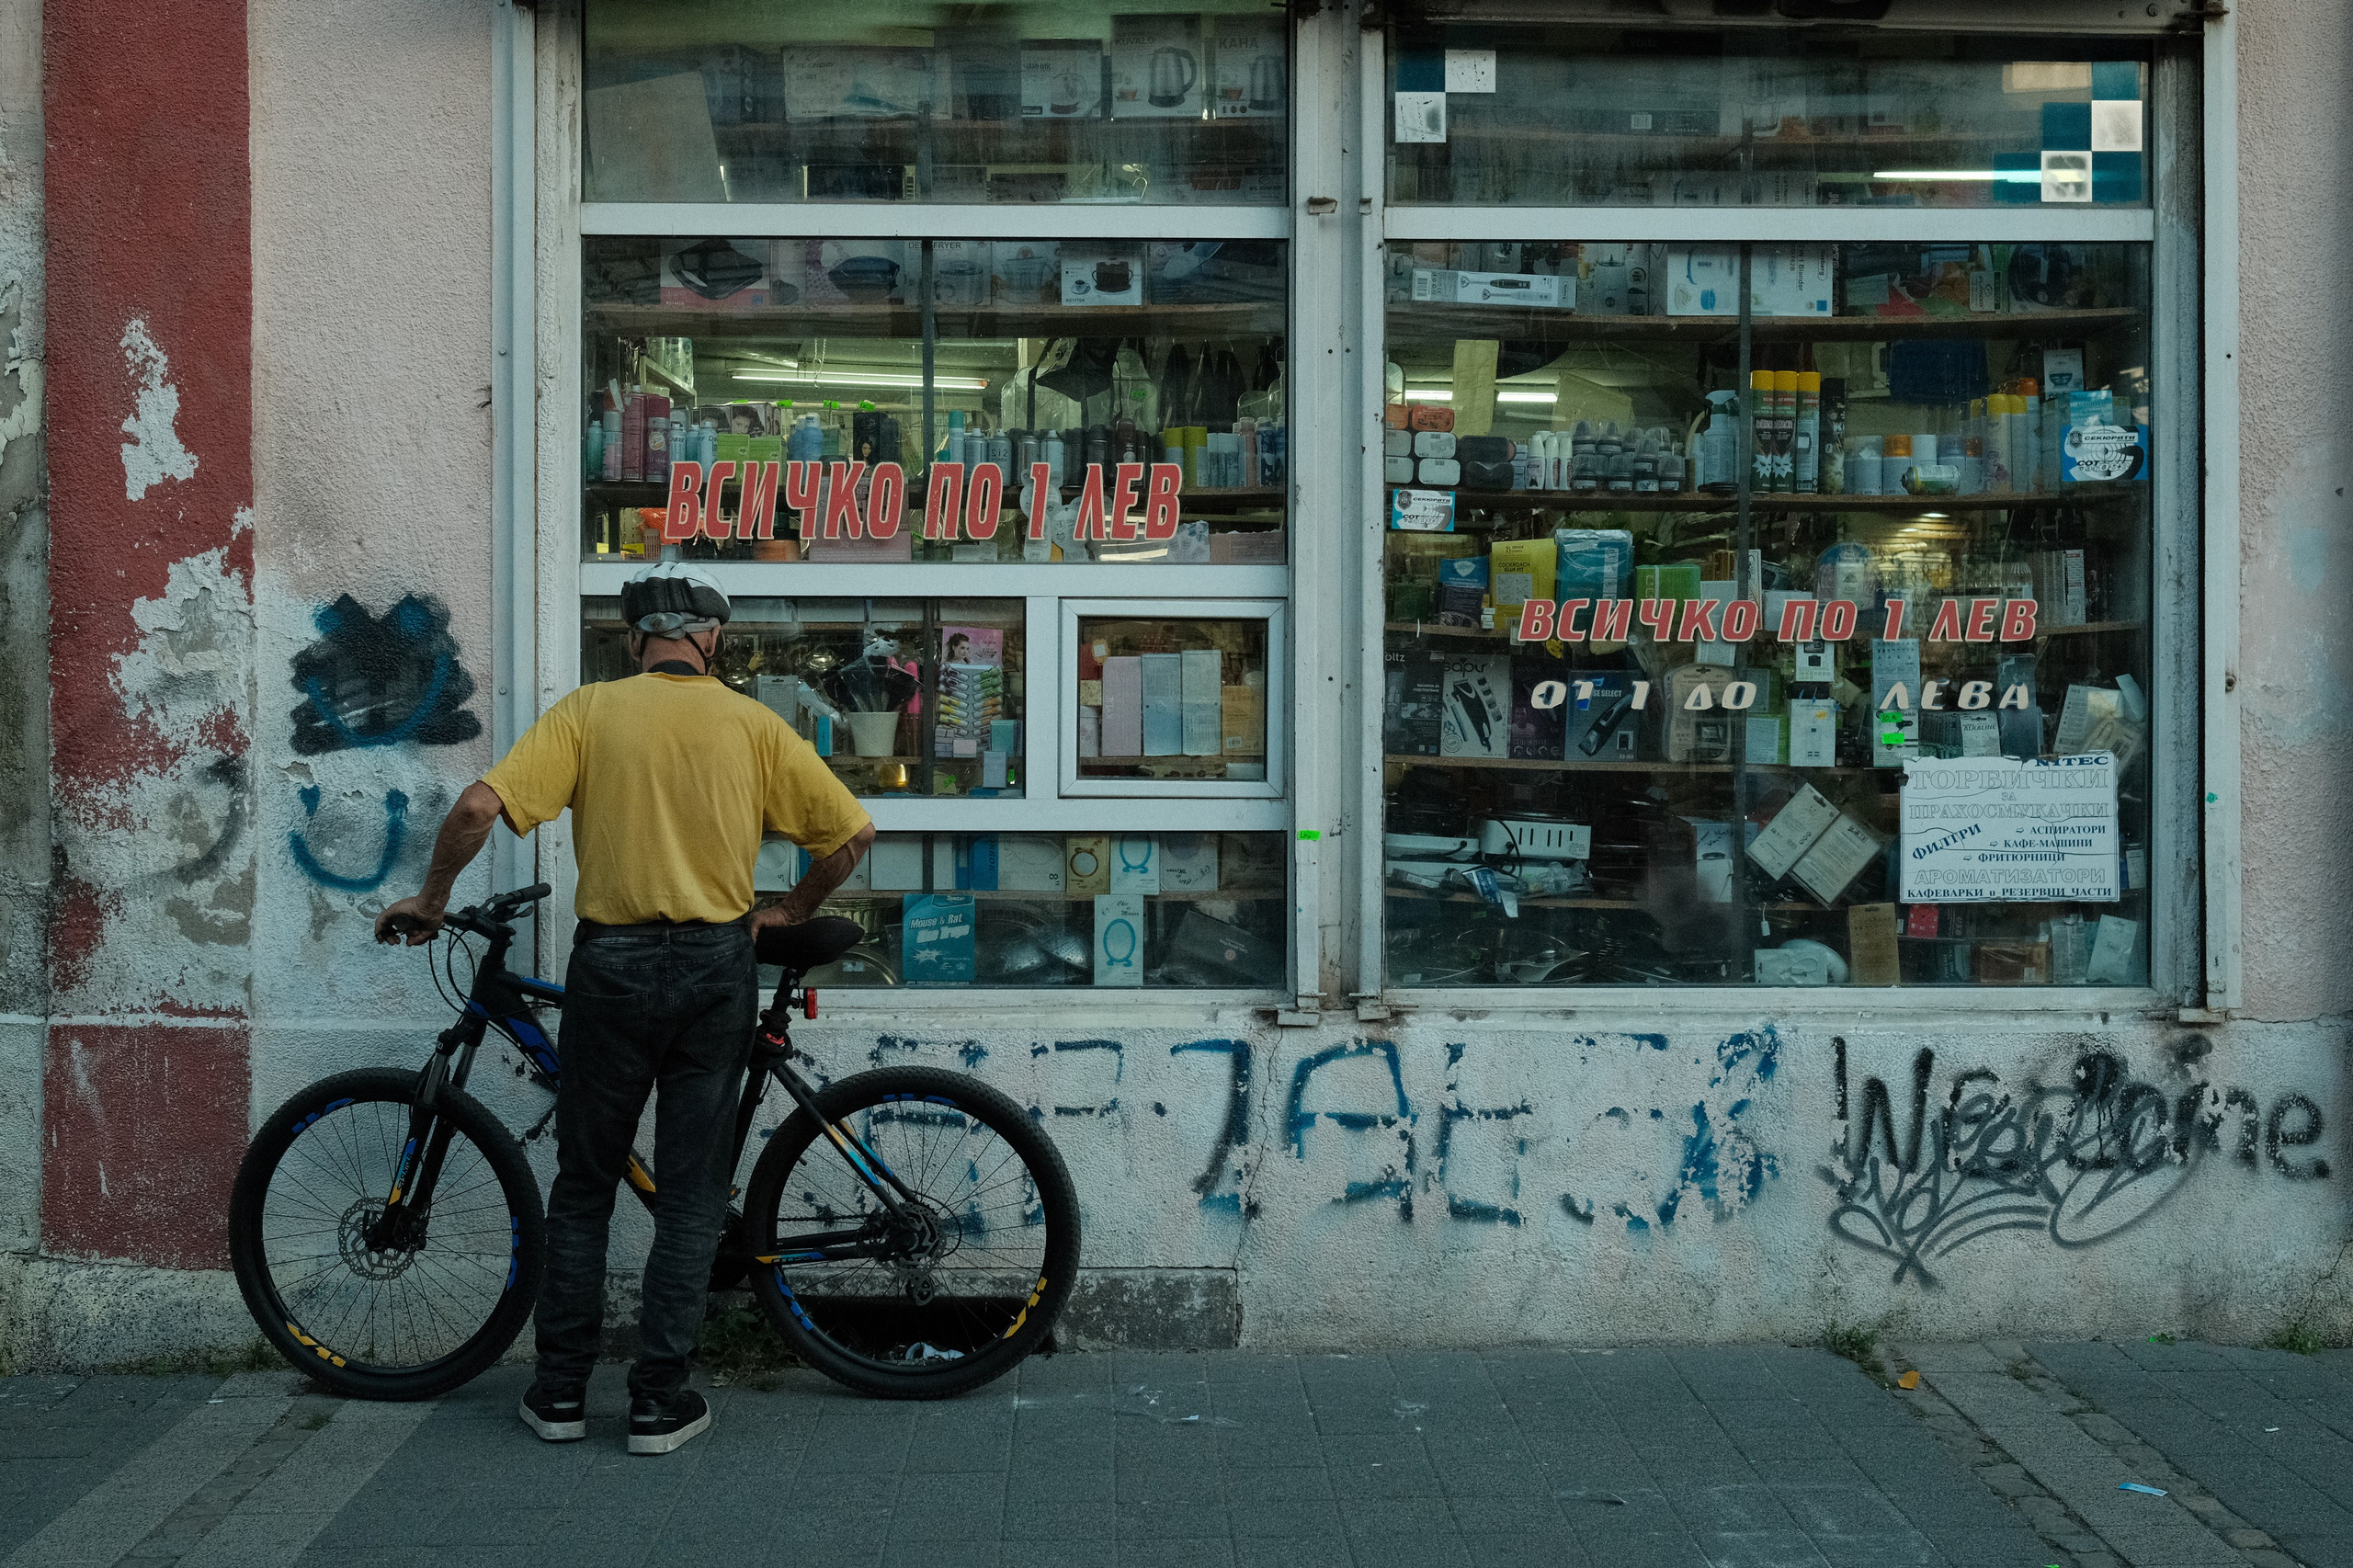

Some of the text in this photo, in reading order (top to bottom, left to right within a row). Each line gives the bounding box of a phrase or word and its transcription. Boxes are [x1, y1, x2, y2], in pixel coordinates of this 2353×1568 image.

[665, 460, 1183, 541] ВСИЧКО ПО 1 ЛЕВ
[1517, 597, 2039, 642] ВСИЧКО ПО 1 ЛЕВ
[1385, 653, 1405, 662] oltz
[1602, 690, 1623, 699] SELECT
[1683, 681, 1759, 711] ДО
[1879, 677, 2029, 711] ЛЕВА
[1963, 723, 1997, 732] ALKALINE
[1909, 768, 2109, 790] ТОРБИЧКИ
[2001, 792, 2018, 801] ЗА
[1909, 803, 2109, 820] ПРАХОСМУКАЧКИ
[2029, 825, 2107, 835] АСПИРАТОРИ
[1912, 823, 1983, 860] ФИЛТРИ
[2004, 839, 2093, 848] КАФЕ-МАШИНИ
[1978, 853, 2066, 863] ФРИТЮРНИЦИ
[1914, 869, 2106, 885] АРОМАТИЗАТОРИ
[1907, 889, 1984, 898] КАФЕВАРКИ
[2002, 888, 2065, 898] РЕЗЕРВНИ
[2072, 888, 2112, 897] ЧАСТИ
[910, 918, 938, 929] Mouse
[948, 914, 962, 925] Rat
